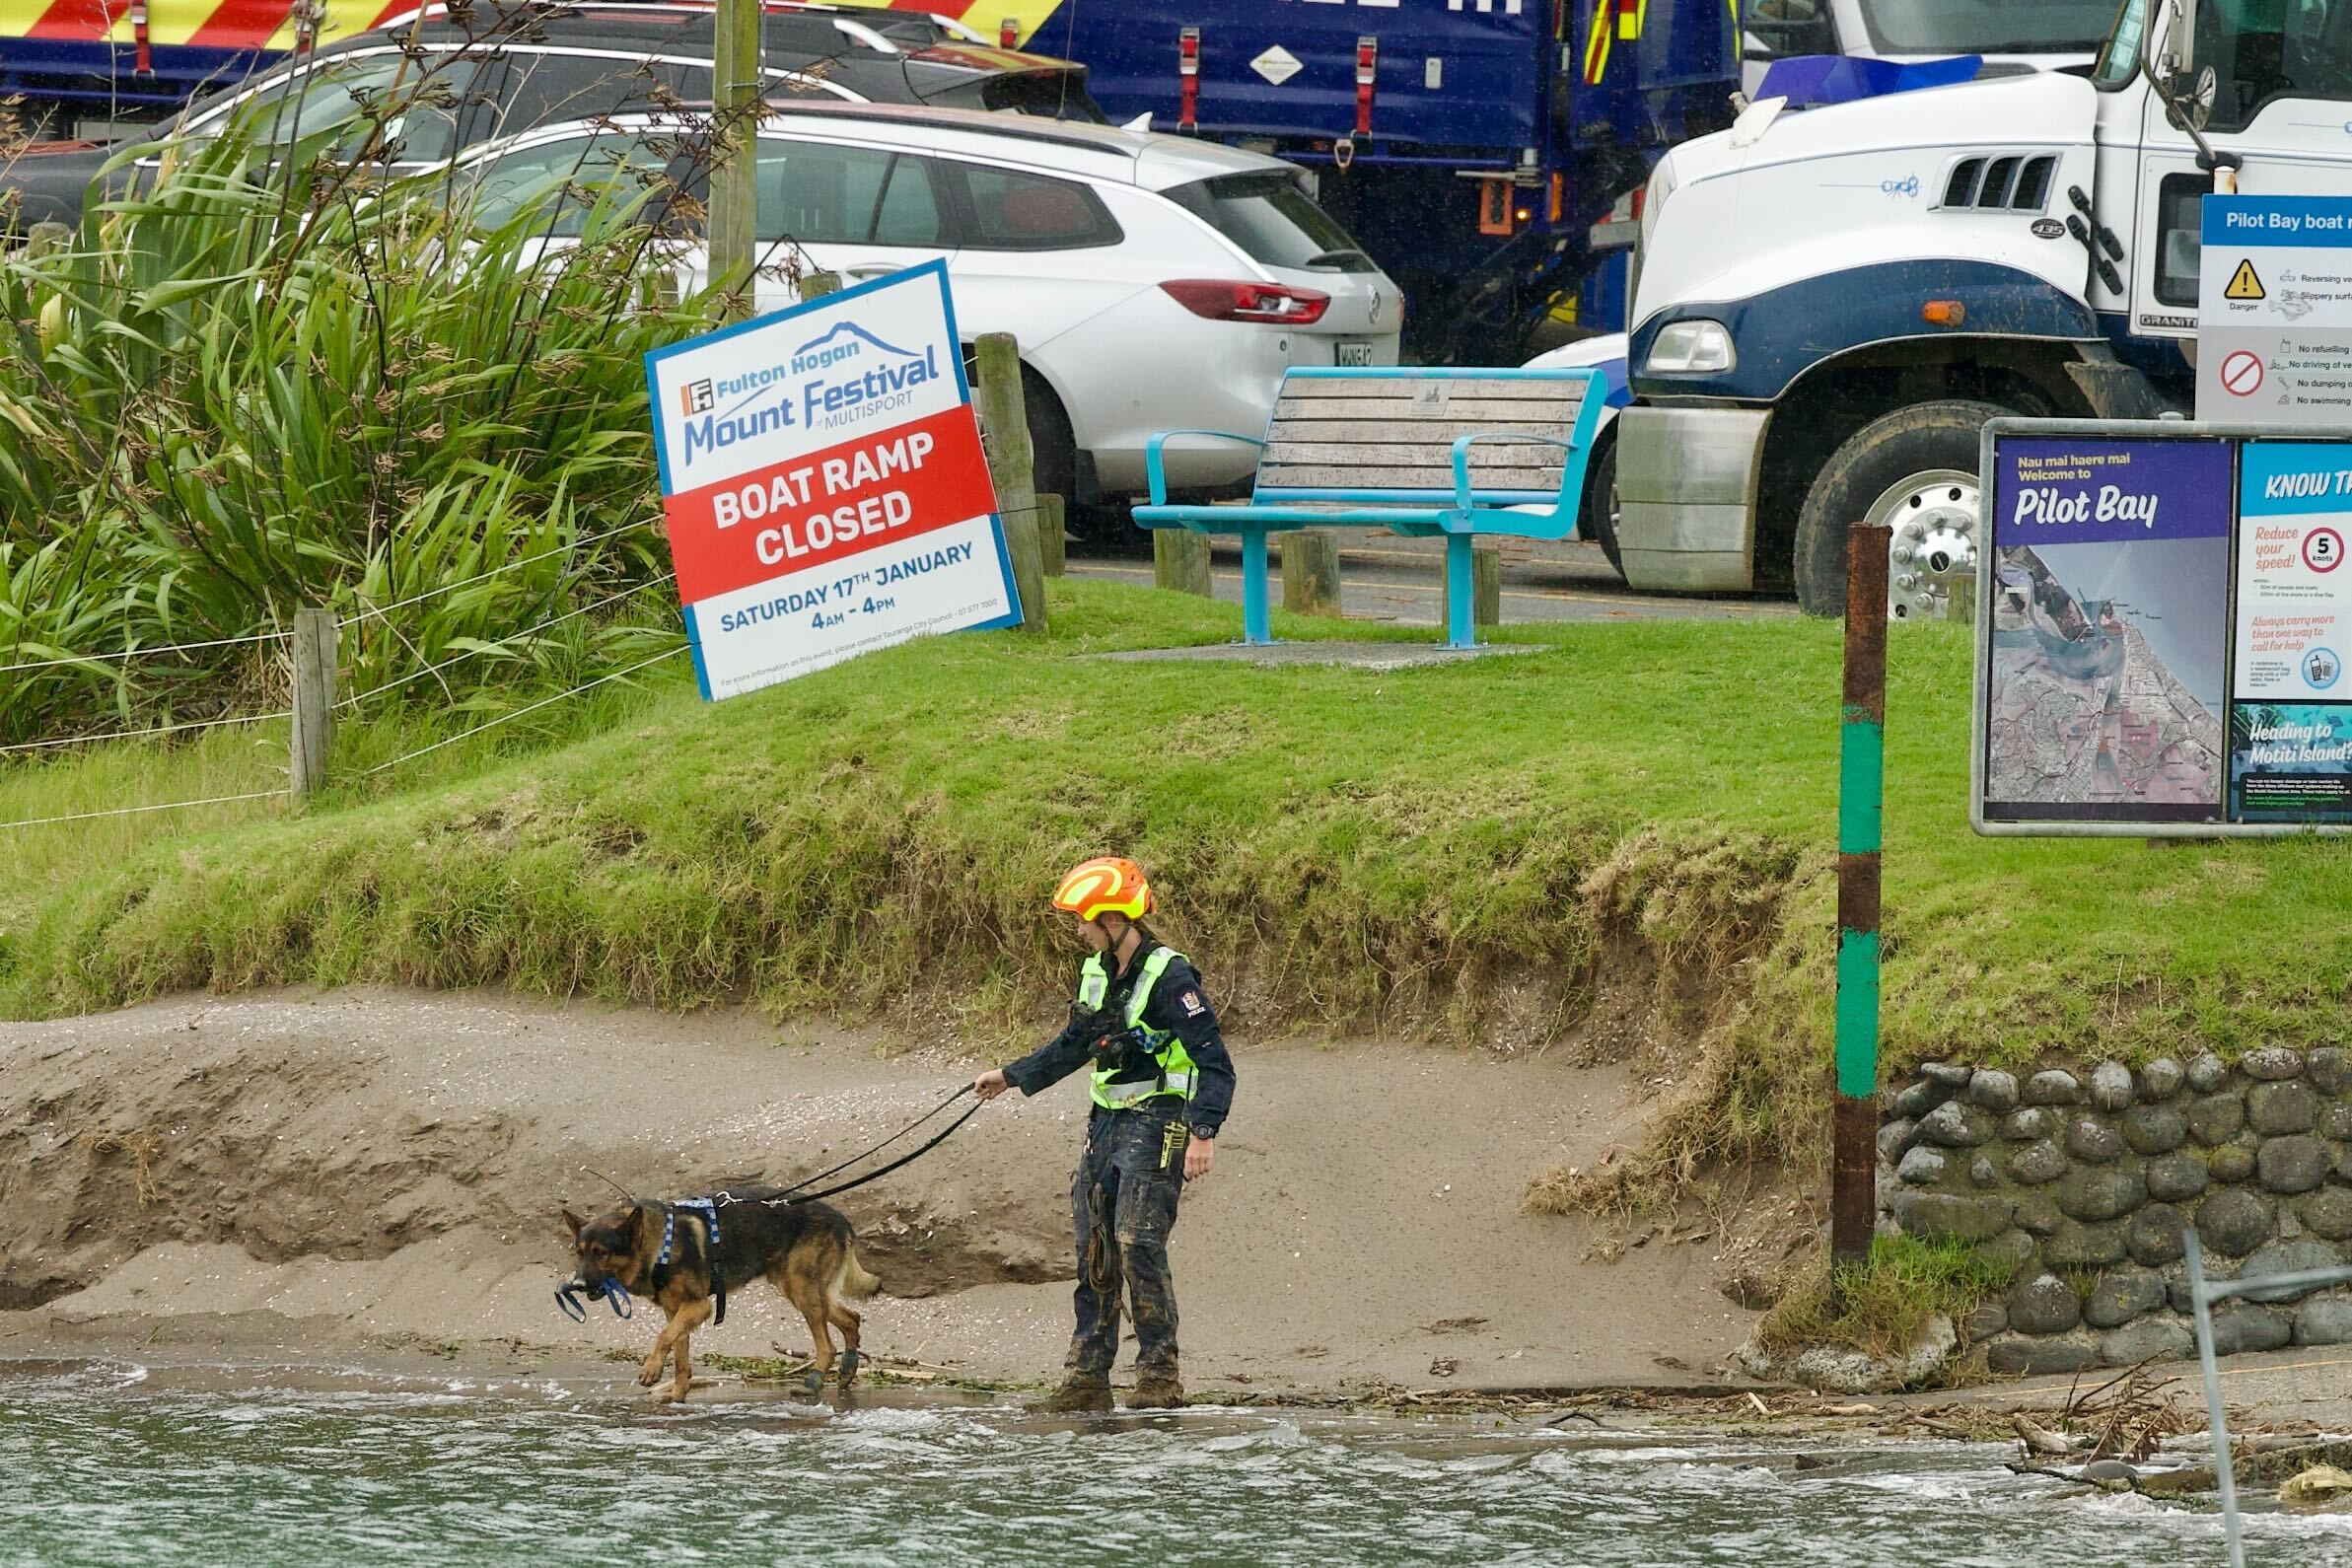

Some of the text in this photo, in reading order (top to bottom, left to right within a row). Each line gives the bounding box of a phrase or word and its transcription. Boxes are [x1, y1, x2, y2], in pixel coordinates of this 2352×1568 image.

[2032, 225, 2064, 235] 435
[2226, 212, 2264, 228] Pilot
[2269, 213, 2301, 232] Bay
[2305, 213, 2343, 229] boat
[2301, 274, 2341, 284] Reversing
[2300, 292, 2332, 301] Slippery
[2229, 303, 2258, 312] Danger
[2312, 345, 2349, 355] refuelling
[717, 341, 860, 398] Fulton Hogan
[2302, 360, 2330, 370] driving
[2311, 380, 2346, 389] dumping
[684, 344, 939, 467] Mount Festival
[2311, 396, 2351, 406] swimming
[825, 390, 913, 431] MULTISPORT
[2018, 453, 2131, 468] Nau mai haere mai
[713, 432, 934, 530] BOAT RAMP
[2019, 468, 2092, 482] Welcome to
[2265, 471, 2330, 499] KNOW
[2014, 484, 2159, 530] Pilot Bay
[755, 490, 912, 565] CLOSED
[2255, 526, 2299, 540] Reduce
[2255, 543, 2284, 558] your
[2317, 537, 2329, 554] 5
[2255, 554, 2296, 572] speed!
[721, 540, 972, 633] SATURDAY 17TH JANUARY
[811, 611, 845, 630] 4AM
[862, 596, 895, 614] 4PM
[2251, 615, 2335, 627] Always carry more
[913, 620, 927, 631] City
[927, 612, 953, 625] Council
[2252, 628, 2275, 639] than
[2293, 630, 2313, 639] way
[2315, 628, 2324, 637] to
[2251, 640, 2304, 653] call for help
[2249, 722, 2333, 743] Heading to
[2249, 742, 2352, 764] Motiti Island?
